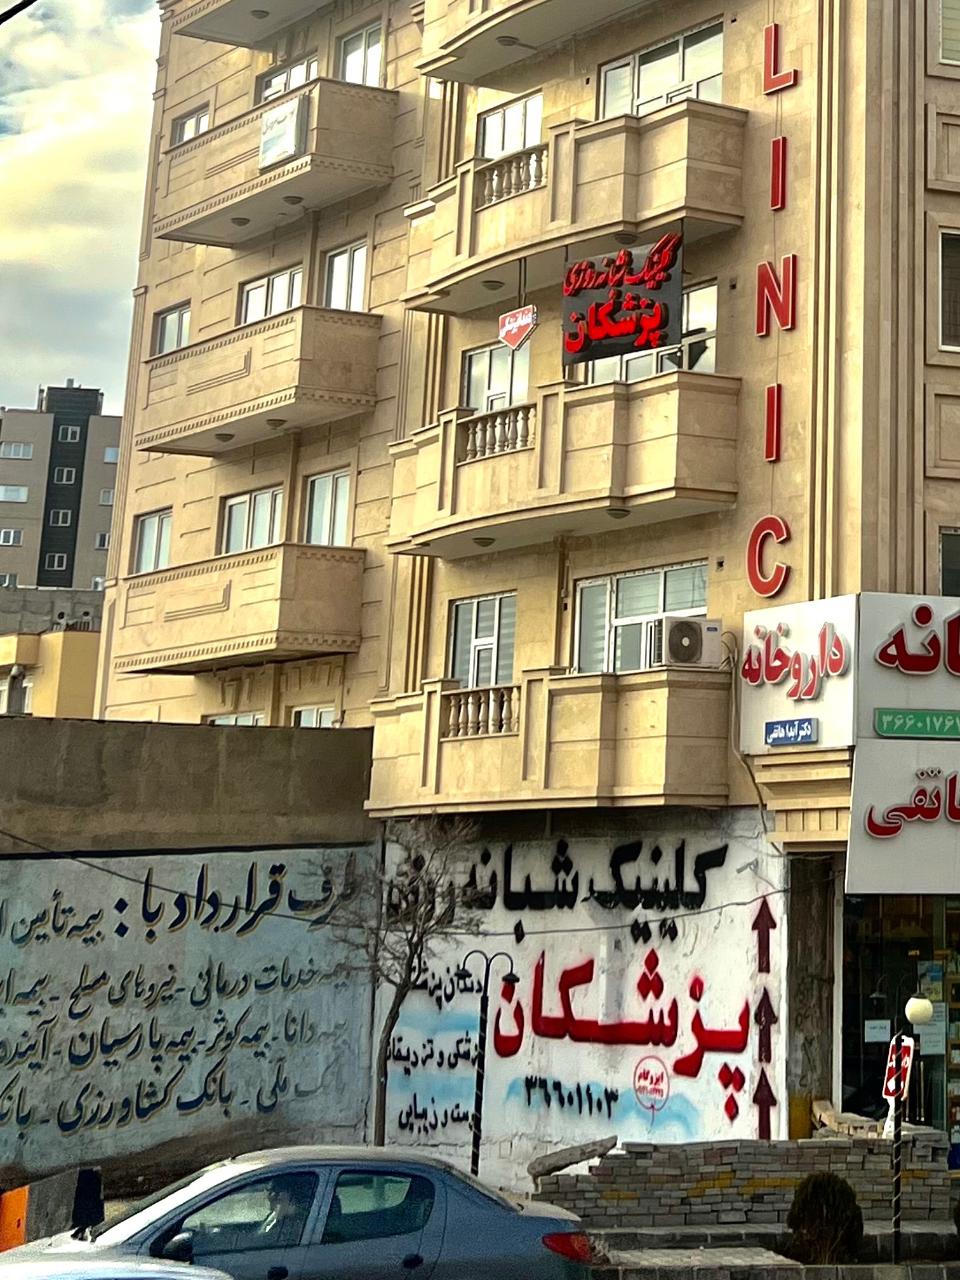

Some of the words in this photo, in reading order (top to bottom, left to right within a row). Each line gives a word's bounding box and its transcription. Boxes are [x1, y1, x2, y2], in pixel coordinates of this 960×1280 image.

[564, 287, 663, 353] پزشکان
[741, 621, 851, 700] داروخانه
[141, 867, 165, 944] با
[166, 862, 286, 936] قرارداد
[461, 838, 580, 945] شبانه
[581, 840, 729, 944] کلینیک
[65, 908, 105, 946] بیمه
[12, 973, 51, 1015] بیمه
[68, 963, 110, 1020] مسلح
[107, 963, 178, 1010] نیروهای
[190, 954, 251, 1009] درمانی
[253, 954, 321, 993] خدمات
[67, 1015, 164, 1073] پارسیان
[164, 1024, 197, 1062] بیمه
[204, 1005, 253, 1056] کوثر
[238, 1021, 273, 1060] بیمه
[284, 1007, 317, 1045] دانا
[448, 1030, 479, 1069] زشکی
[493, 946, 751, 1124] پزشکان
[436, 1048, 444, 1068] و
[57, 1064, 186, 1135] کشاورزی
[176, 1055, 235, 1118] بانک
[398, 1092, 439, 1135] زیبایی
[441, 1108, 448, 1128] و
